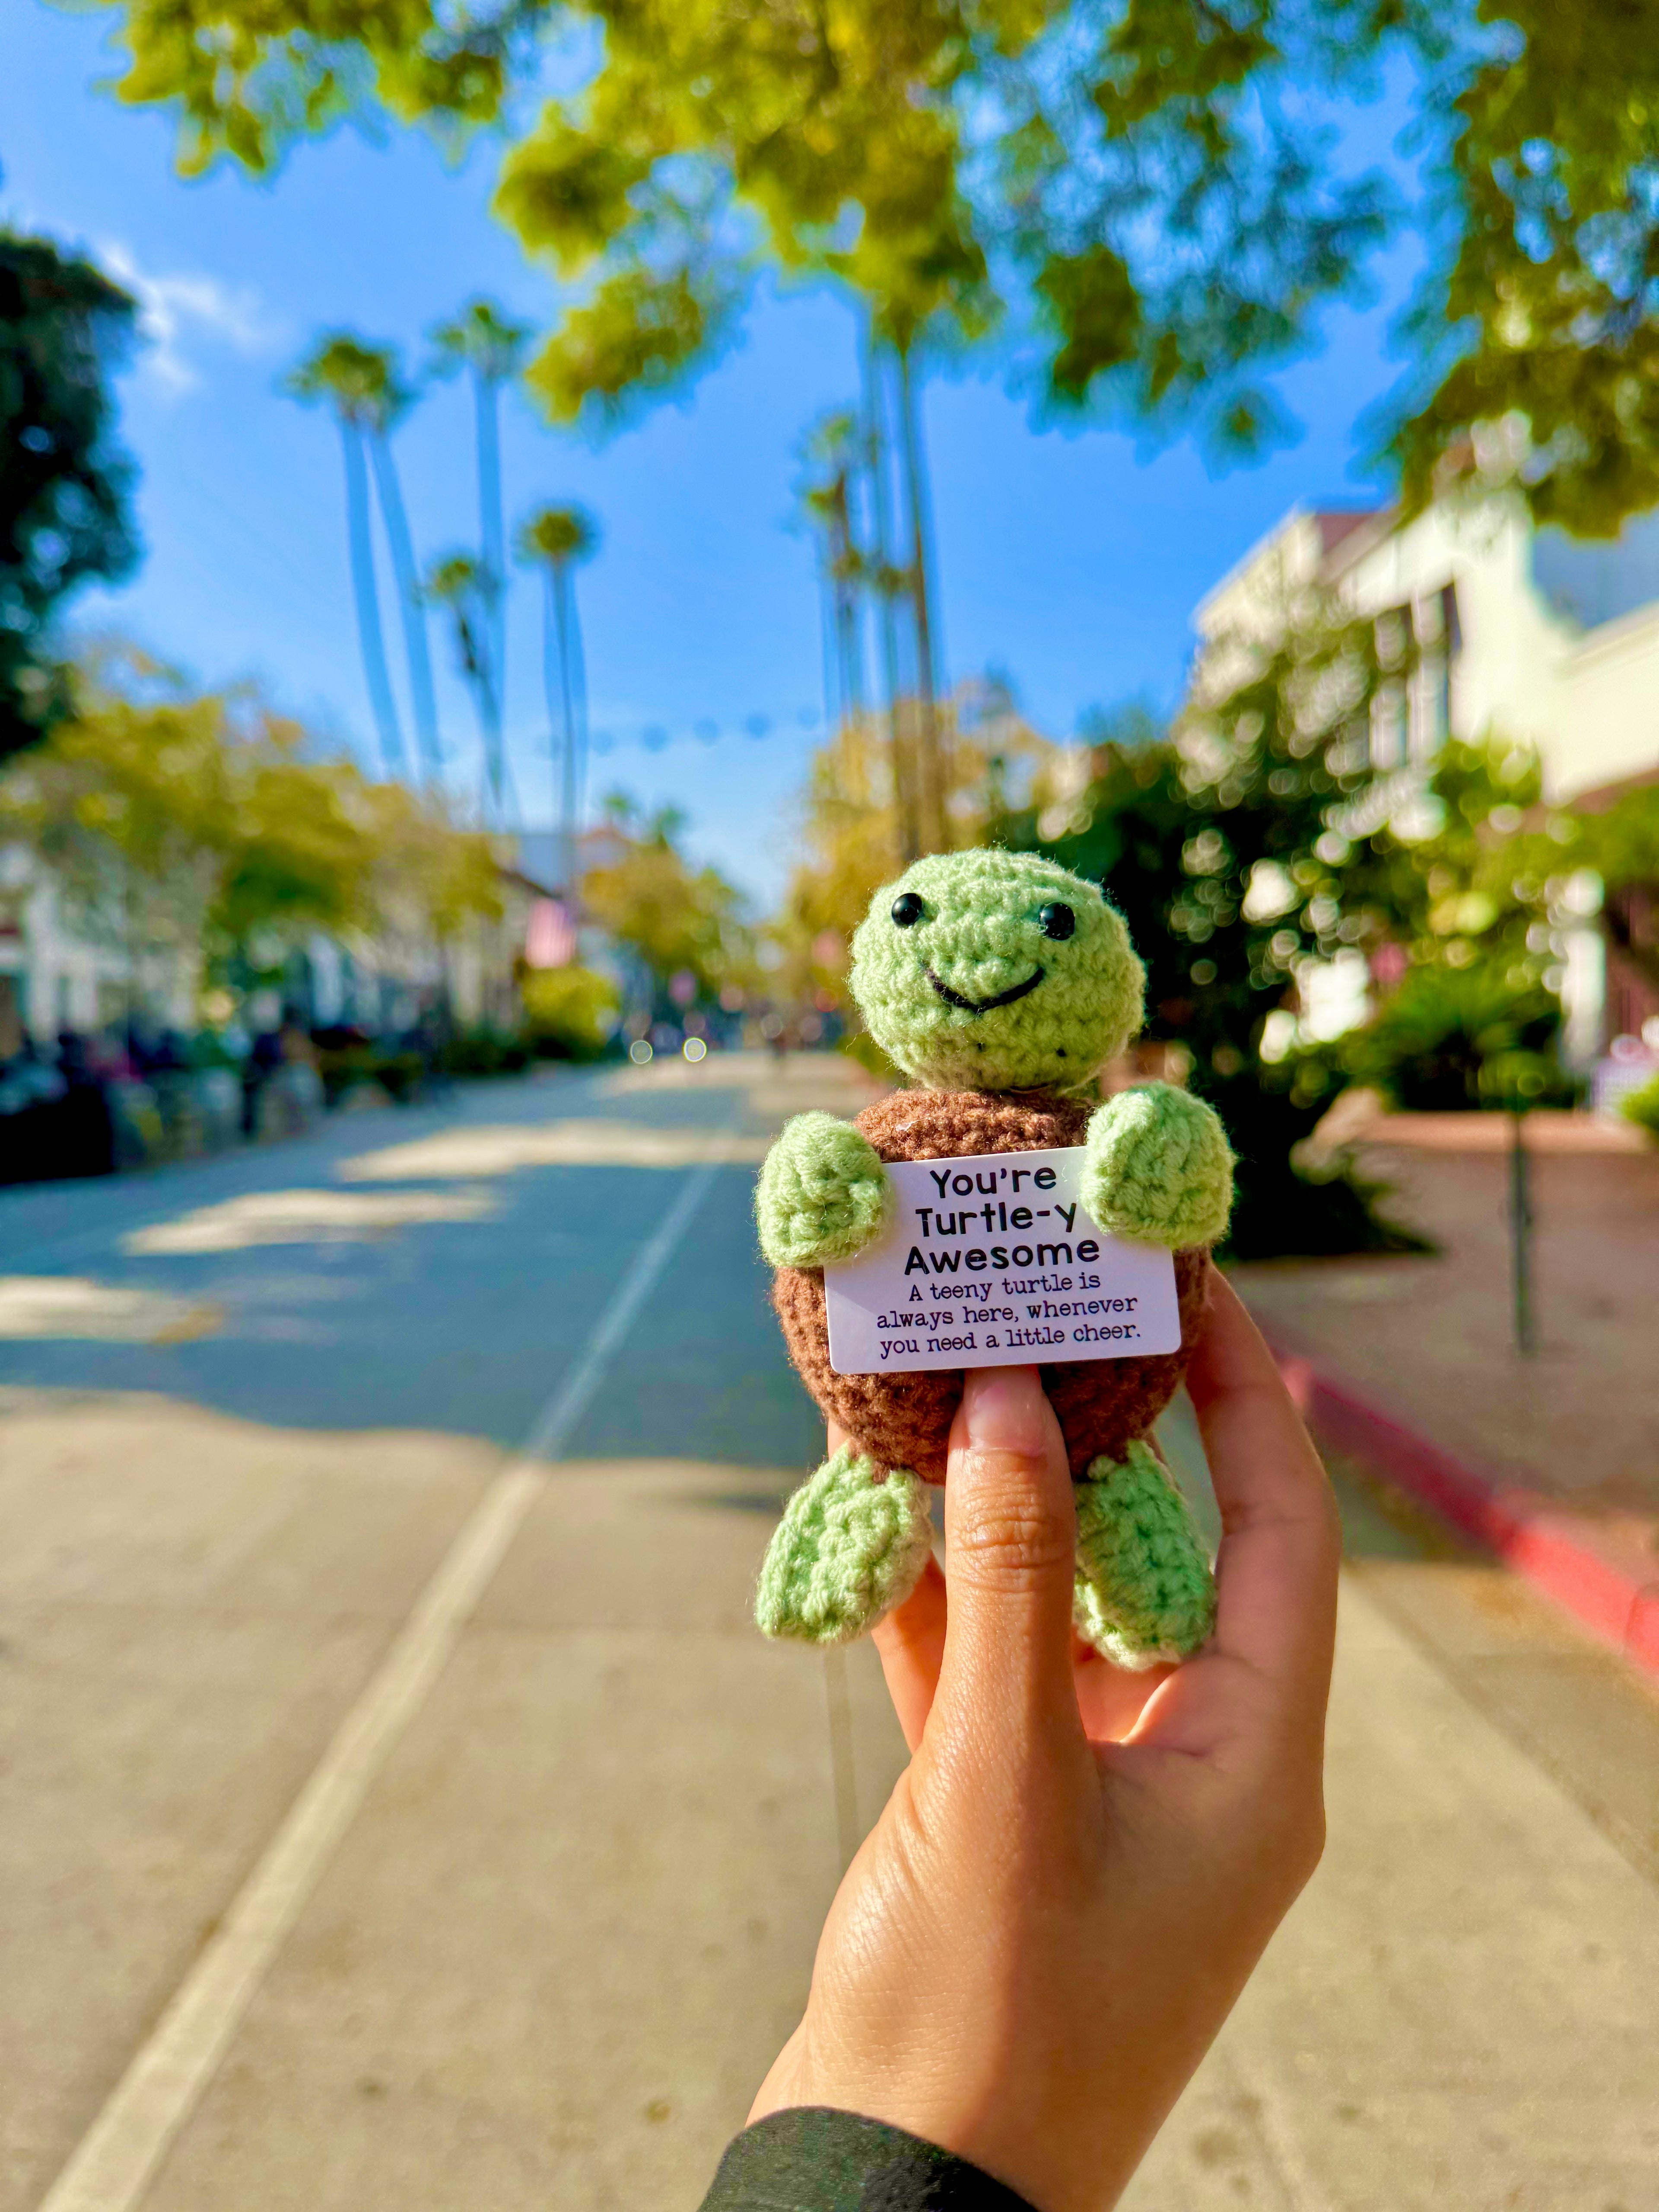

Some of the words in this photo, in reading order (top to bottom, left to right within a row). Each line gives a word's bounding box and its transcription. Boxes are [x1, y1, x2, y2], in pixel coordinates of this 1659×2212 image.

[929, 1167, 1057, 1199] You're
[915, 1201, 1077, 1237] Turtle-y
[904, 1239, 1100, 1276] Awesome
[909, 1284, 923, 1302] A
[929, 1283, 993, 1302] teeny
[1001, 1274, 1073, 1295] turtle
[1078, 1271, 1101, 1290] is
[877, 1310, 954, 1331] always
[962, 1306, 1019, 1323] here,
[1026, 1297, 1138, 1319] whenever
[880, 1339, 920, 1360] you
[926, 1332, 978, 1352] need
[985, 1335, 1000, 1348] a
[1005, 1326, 1065, 1347] little
[1073, 1324, 1141, 1342] cheer.
